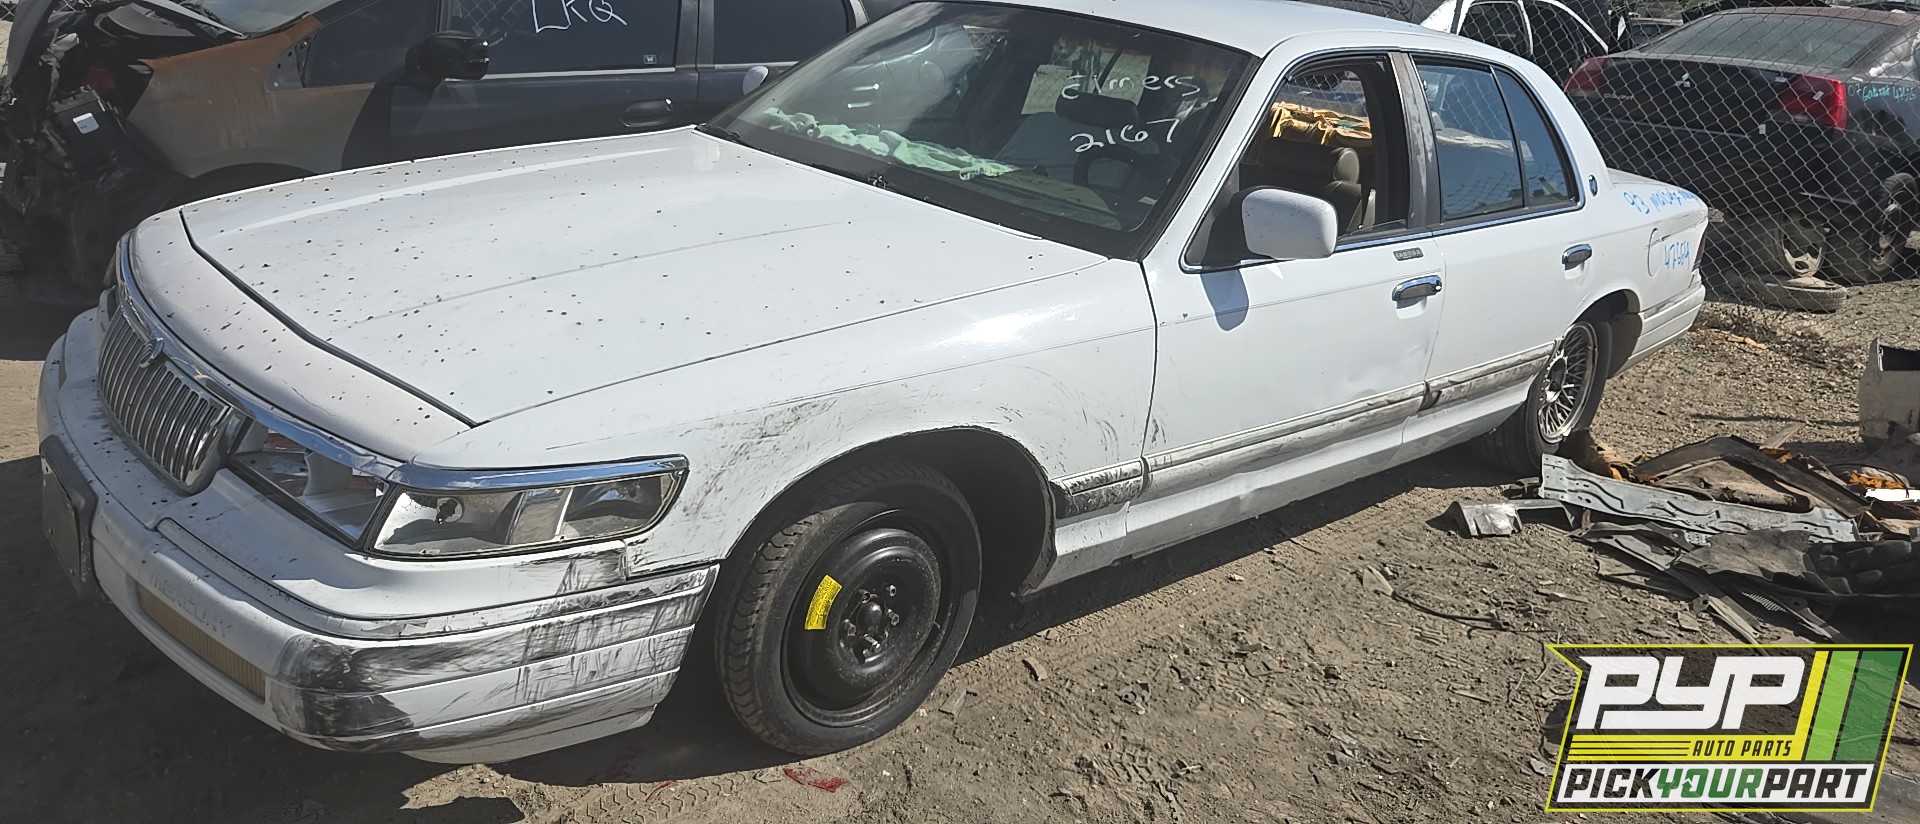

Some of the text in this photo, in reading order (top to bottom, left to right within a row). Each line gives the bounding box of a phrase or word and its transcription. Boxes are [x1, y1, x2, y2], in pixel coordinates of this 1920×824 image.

[531, 0, 627, 33] LKQ
[1069, 117, 1179, 153] 2167
[150, 571, 233, 638] MERCURY
